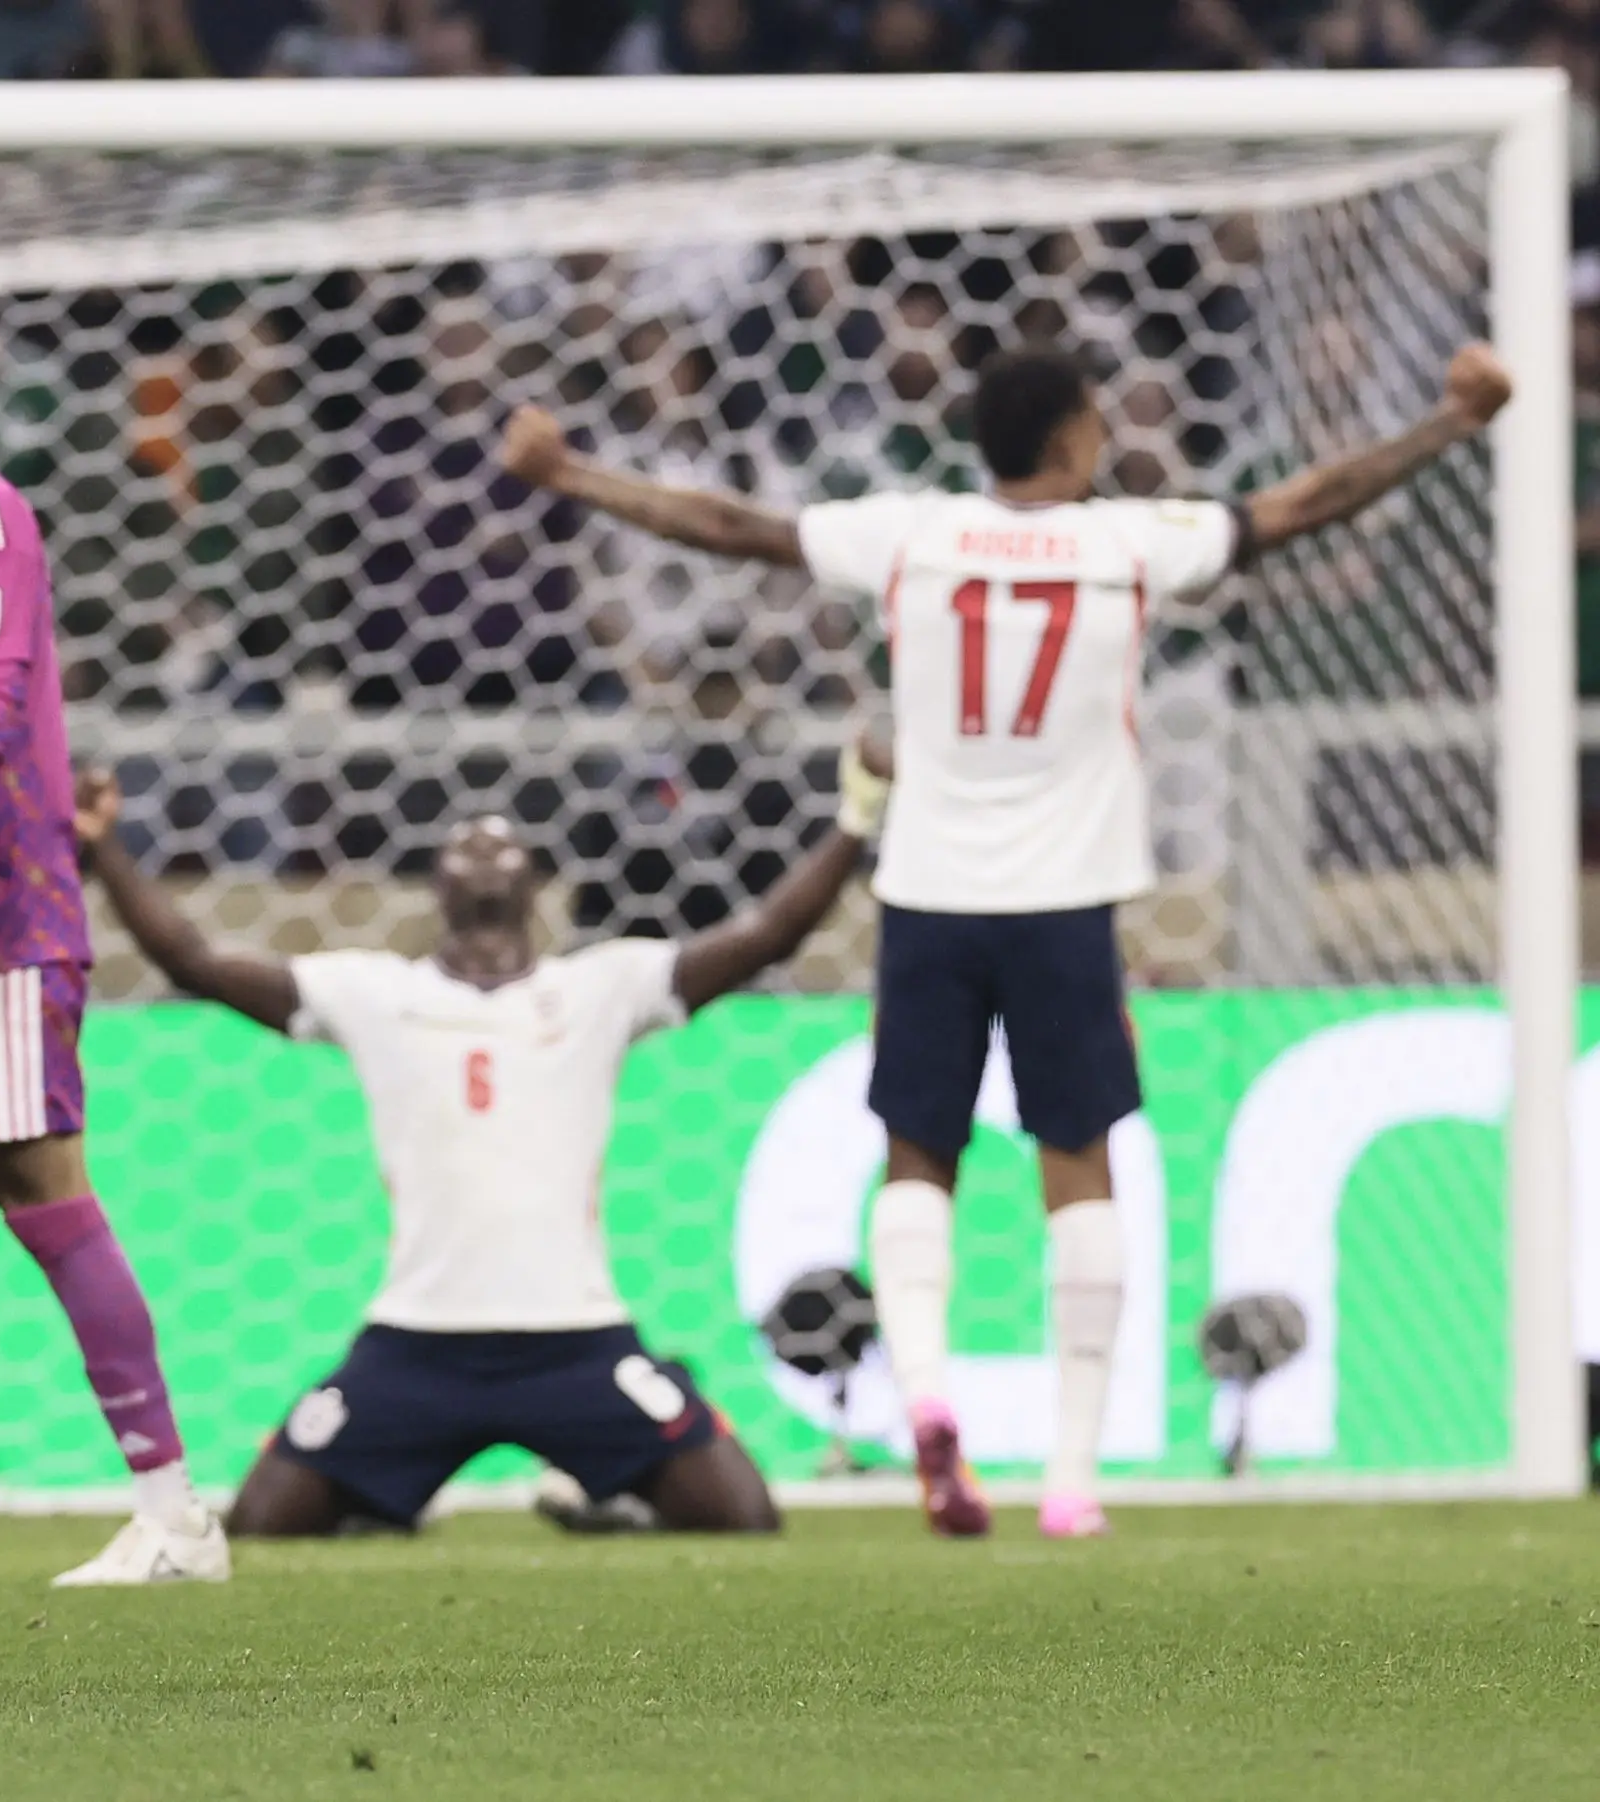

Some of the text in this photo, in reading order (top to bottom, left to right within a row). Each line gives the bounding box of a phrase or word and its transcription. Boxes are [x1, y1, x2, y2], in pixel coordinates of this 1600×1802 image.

[950, 577, 1078, 738] 17
[466, 1048, 493, 1113] 6
[613, 1353, 686, 1423] 6
